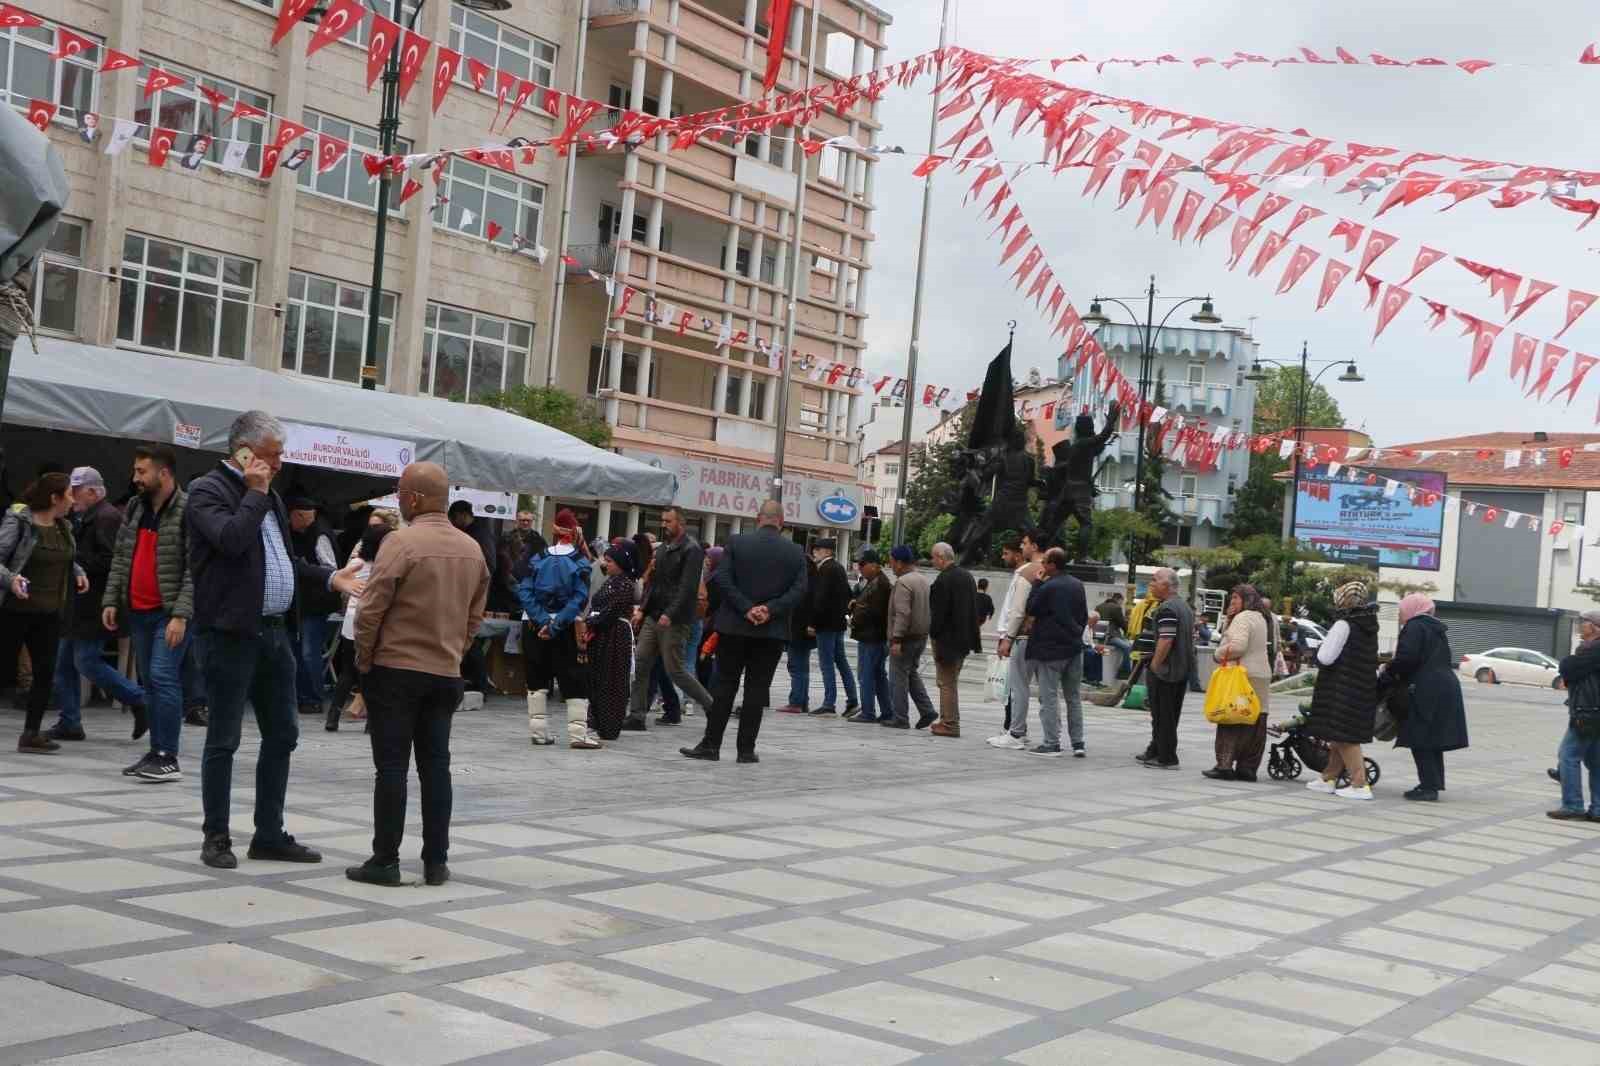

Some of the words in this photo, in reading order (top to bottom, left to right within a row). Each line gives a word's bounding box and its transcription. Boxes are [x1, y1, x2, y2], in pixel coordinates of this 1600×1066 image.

[337, 435, 347, 446] T.C.
[313, 442, 342, 457] BURDUR
[290, 449, 317, 464] KÜLTÜR
[318, 456, 327, 465] VE
[327, 456, 353, 467] TURİZM
[700, 466, 760, 491] FABRİKA
[766, 475, 800, 501] STIŞ
